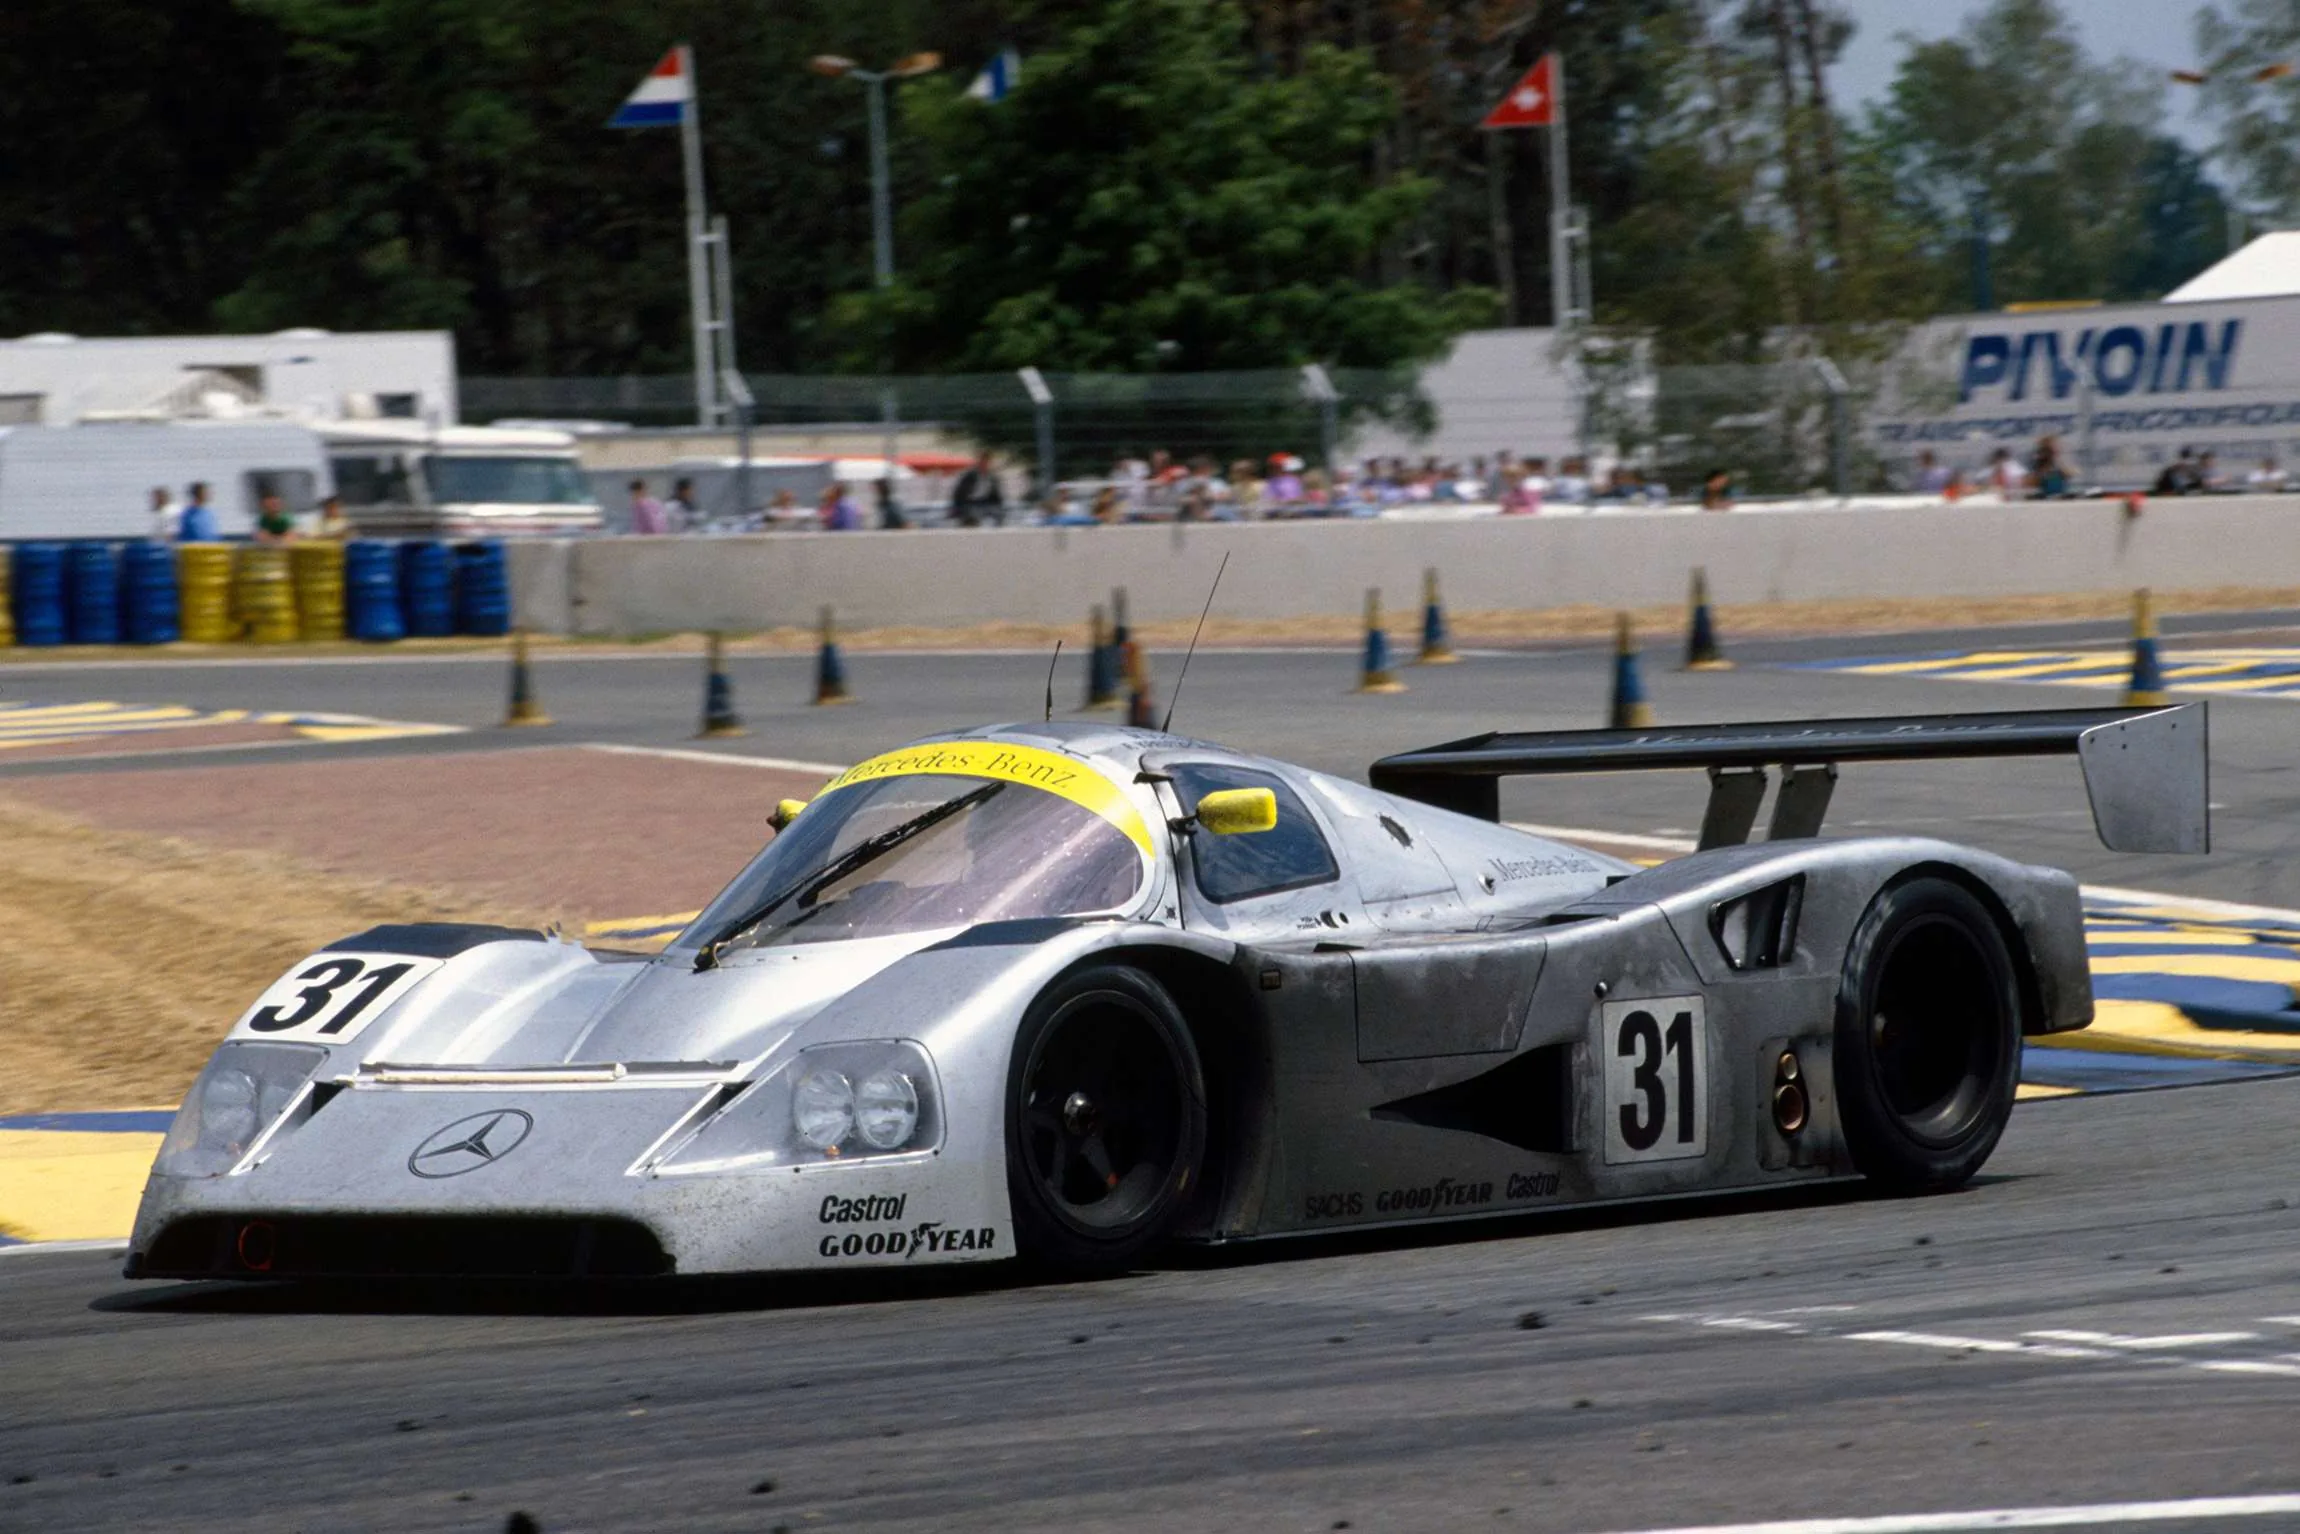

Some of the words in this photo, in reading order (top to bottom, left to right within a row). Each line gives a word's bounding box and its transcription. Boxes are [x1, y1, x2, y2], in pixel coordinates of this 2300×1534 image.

[1958, 318, 2245, 403] PIVOIN
[249, 957, 416, 1035] 31
[1616, 1010, 1695, 1152] 31
[818, 1193, 908, 1224] Castrol
[1304, 1191, 1364, 1220] SACHS
[1506, 1170, 1561, 1199] Castrol
